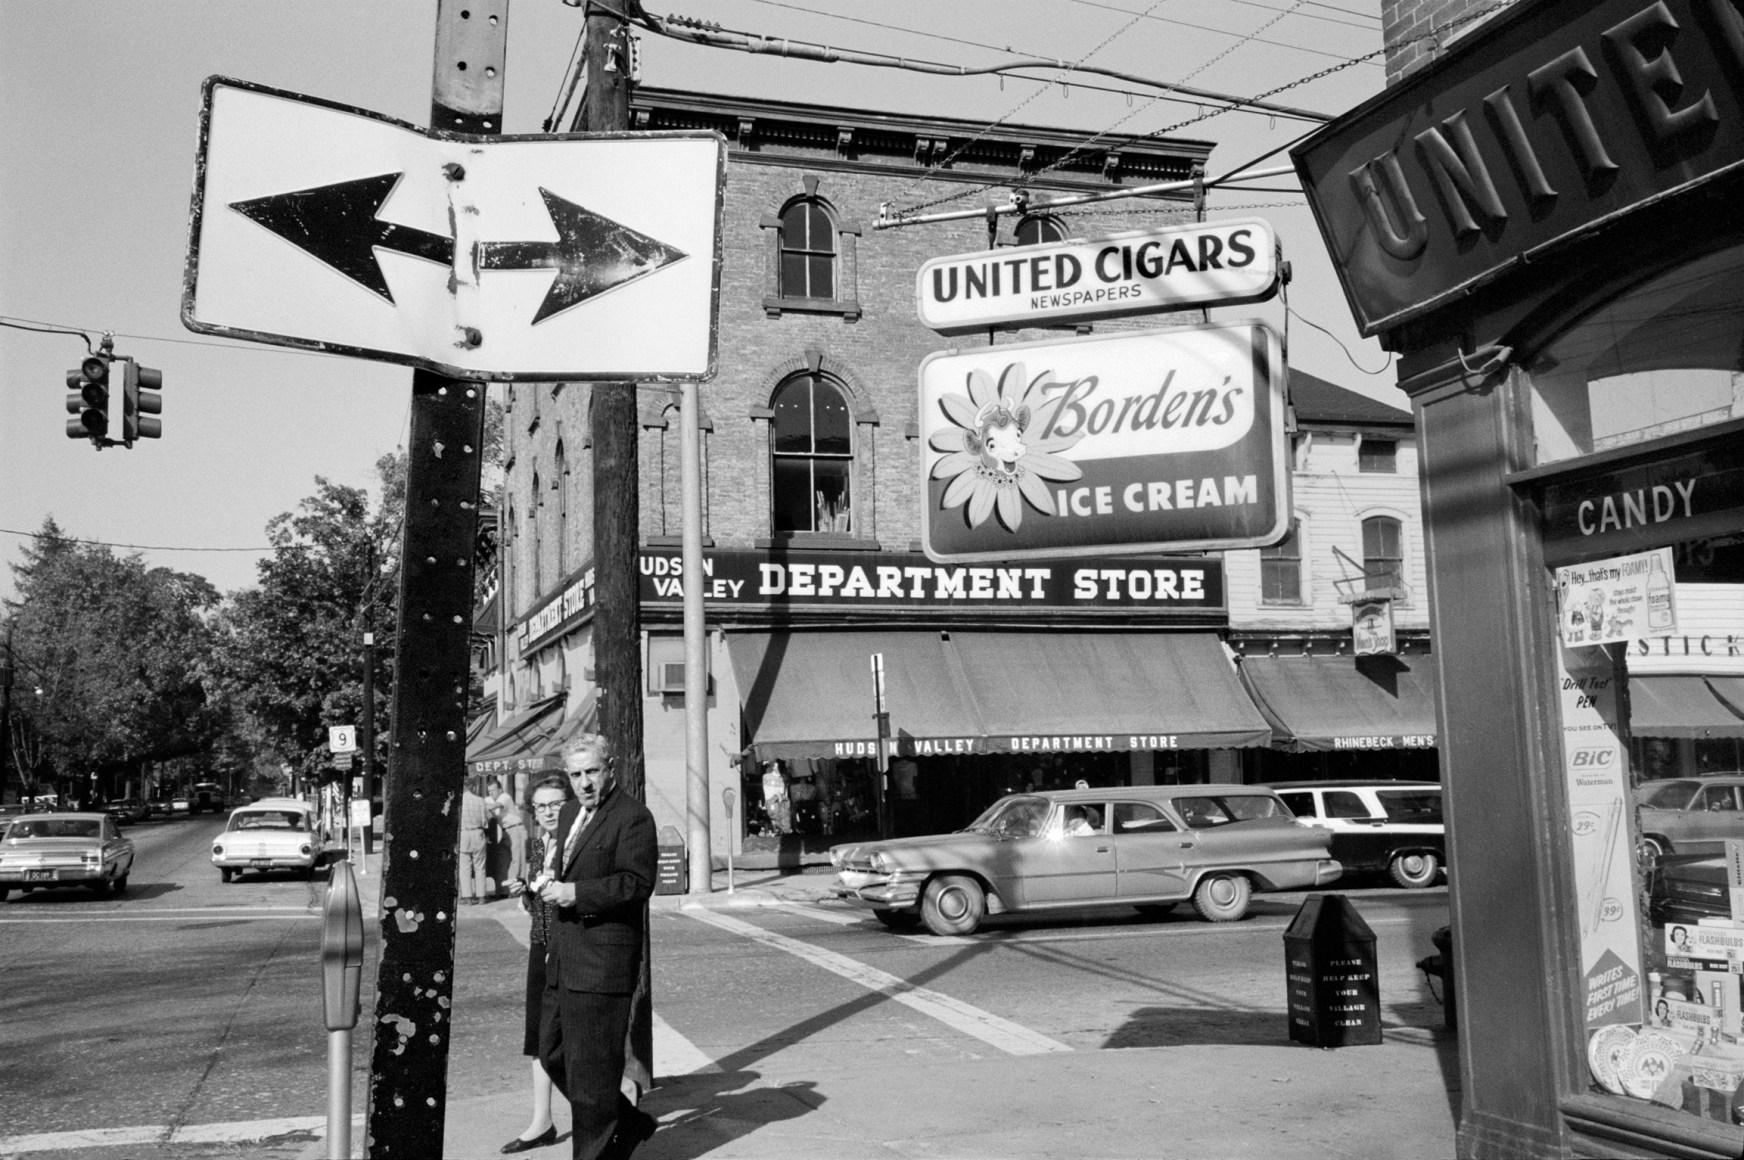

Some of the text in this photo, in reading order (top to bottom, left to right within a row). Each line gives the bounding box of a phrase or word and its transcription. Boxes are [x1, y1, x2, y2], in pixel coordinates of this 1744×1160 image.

[1349, 0, 1744, 262] UNITE
[932, 229, 1256, 303] UNITED CIGARS
[1031, 284, 1142, 310] NEWSPAPERS
[1040, 369, 1244, 441] Borden's
[1058, 475, 1258, 517] ICE CREAM
[1578, 478, 1696, 536] CANDY
[639, 556, 713, 577] UDSN
[653, 578, 745, 598] VAEY
[758, 562, 1205, 600] DEPARTMENT STORE
[1576, 695, 1598, 709] PEN
[338, 732, 347, 747] 9
[835, 735, 1178, 755] HUDSN VALLEY DEPARTMENT STORE
[1334, 735, 1434, 749] RHINEBECK MEN'S
[476, 760, 512, 772] DEPT.
[1576, 778, 1613, 787] Waterman
[1699, 935, 1744, 948] FLASHBULBS
[1330, 958, 1362, 967] PLEASE
[1323, 973, 1371, 983] HELP KEEP
[1588, 965, 1624, 991] WRITES
[1336, 989, 1359, 997] YOUR
[1586, 974, 1637, 1007] FIRST TIME
[1329, 1004, 1366, 1012] VILLAGE
[1586, 998, 1616, 1022] EVERY
[1676, 1008, 1711, 1026] FLASHBULBS
[1335, 1018, 1362, 1027] CLEAN
